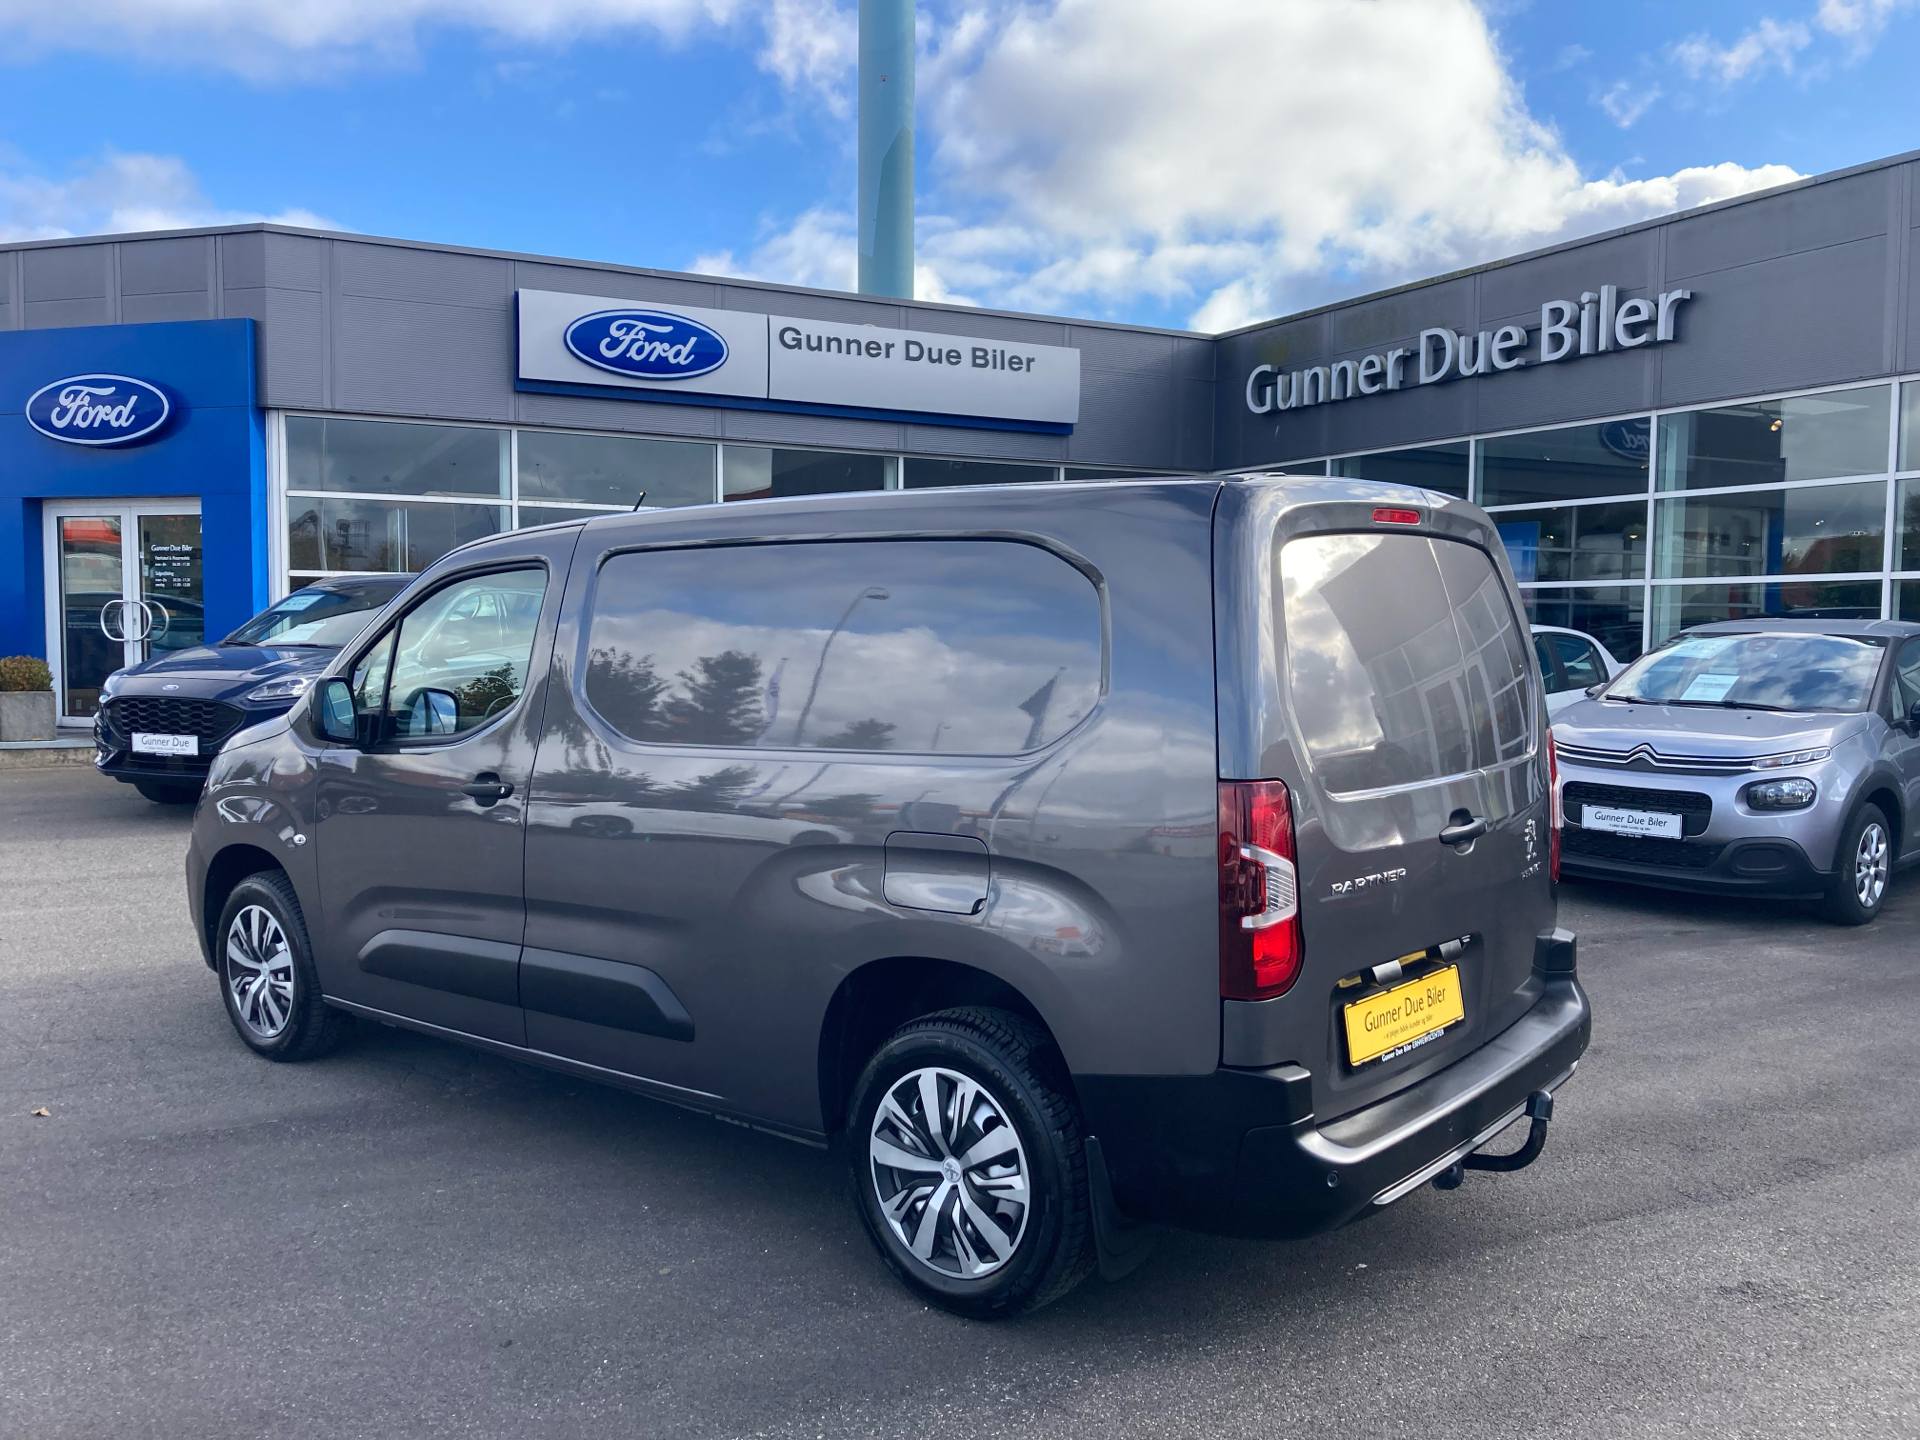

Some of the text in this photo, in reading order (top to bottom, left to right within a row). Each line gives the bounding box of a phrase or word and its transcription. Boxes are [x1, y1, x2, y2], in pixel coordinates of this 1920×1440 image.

[599, 318, 698, 366] Ford
[778, 326, 1036, 373] Gunner Due Biler
[1245, 285, 1691, 414] Gunner Due Biler
[50, 385, 138, 429] Ford
[141, 735, 190, 748] Gunner Due
[1594, 810, 1625, 824] Gunner
[1626, 814, 1645, 826] Due
[1647, 816, 1668, 828] Biler
[1330, 867, 1407, 897] PARTNER
[1364, 985, 1446, 1033] Gunner Due Biler
